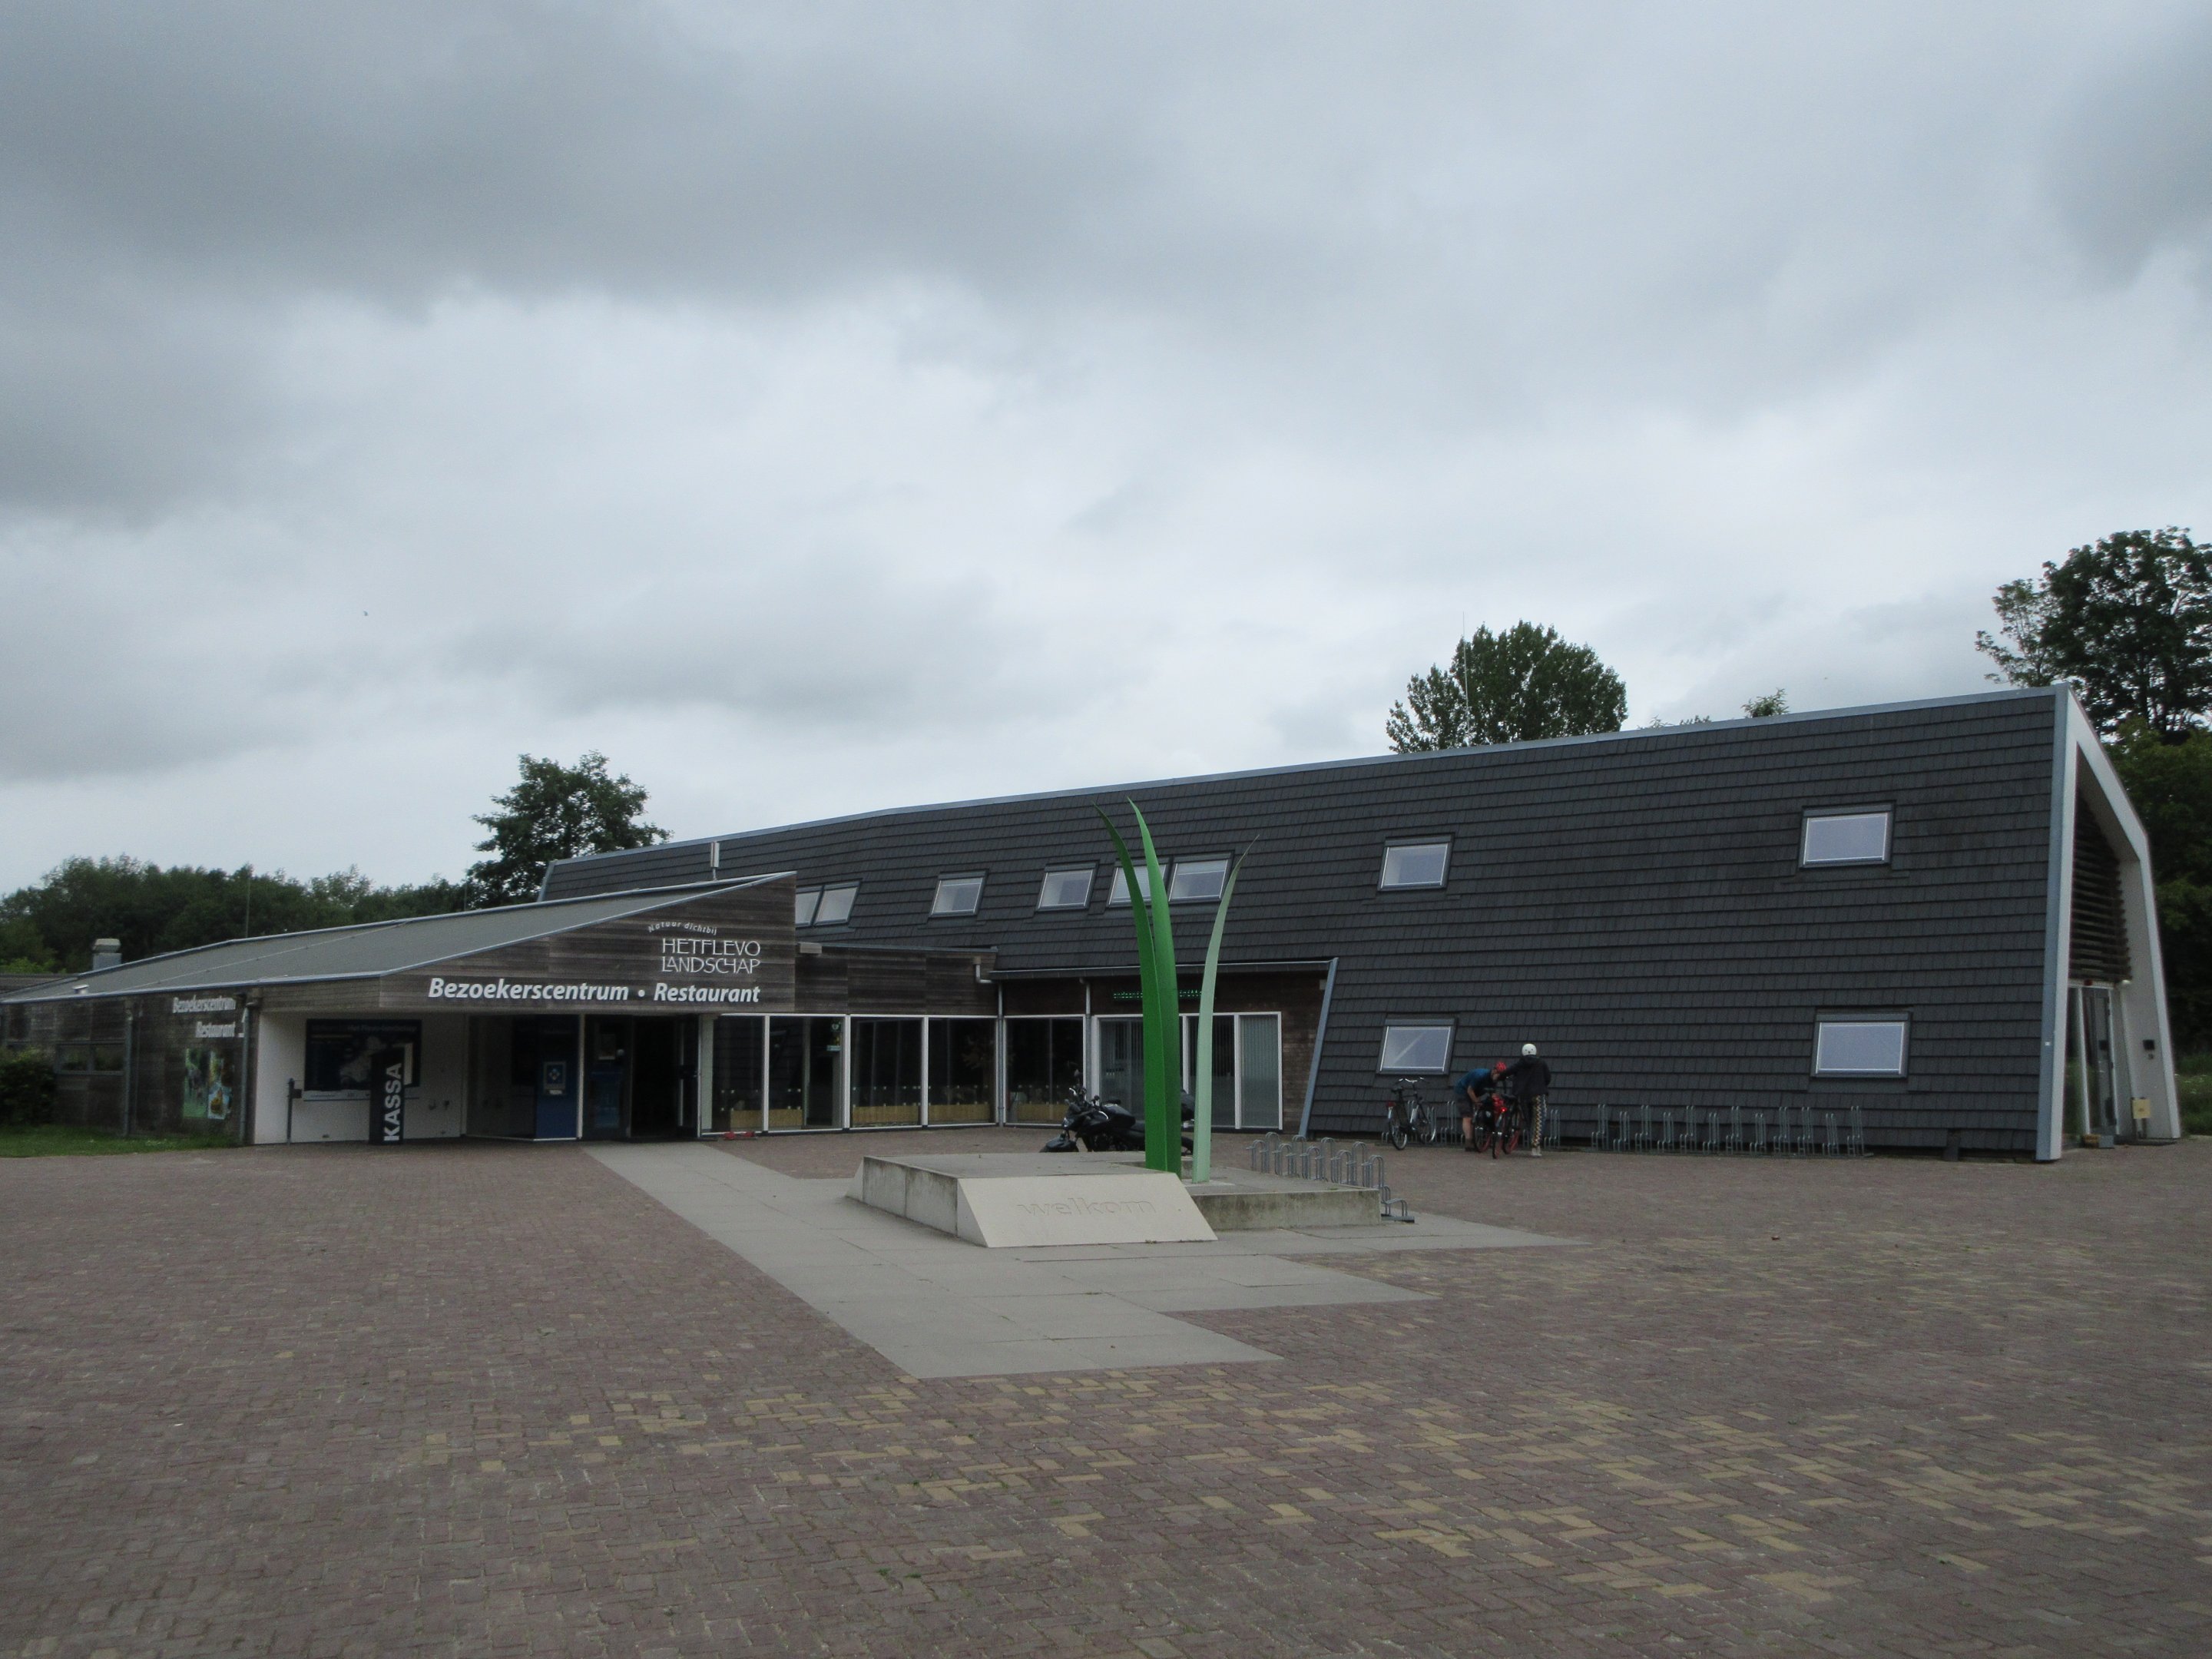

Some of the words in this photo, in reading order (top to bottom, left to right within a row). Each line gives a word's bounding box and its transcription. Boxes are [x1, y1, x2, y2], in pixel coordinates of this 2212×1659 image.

[648, 922, 681, 932] Natuur
[684, 922, 717, 935] dichtbij
[662, 956, 761, 974] LANDSCHAP
[429, 978, 628, 1000] Bezoekerscentrum
[654, 982, 760, 1002] Restaurant
[384, 1063, 402, 1141] KASSA
[1017, 1197, 1156, 1216] welkom
